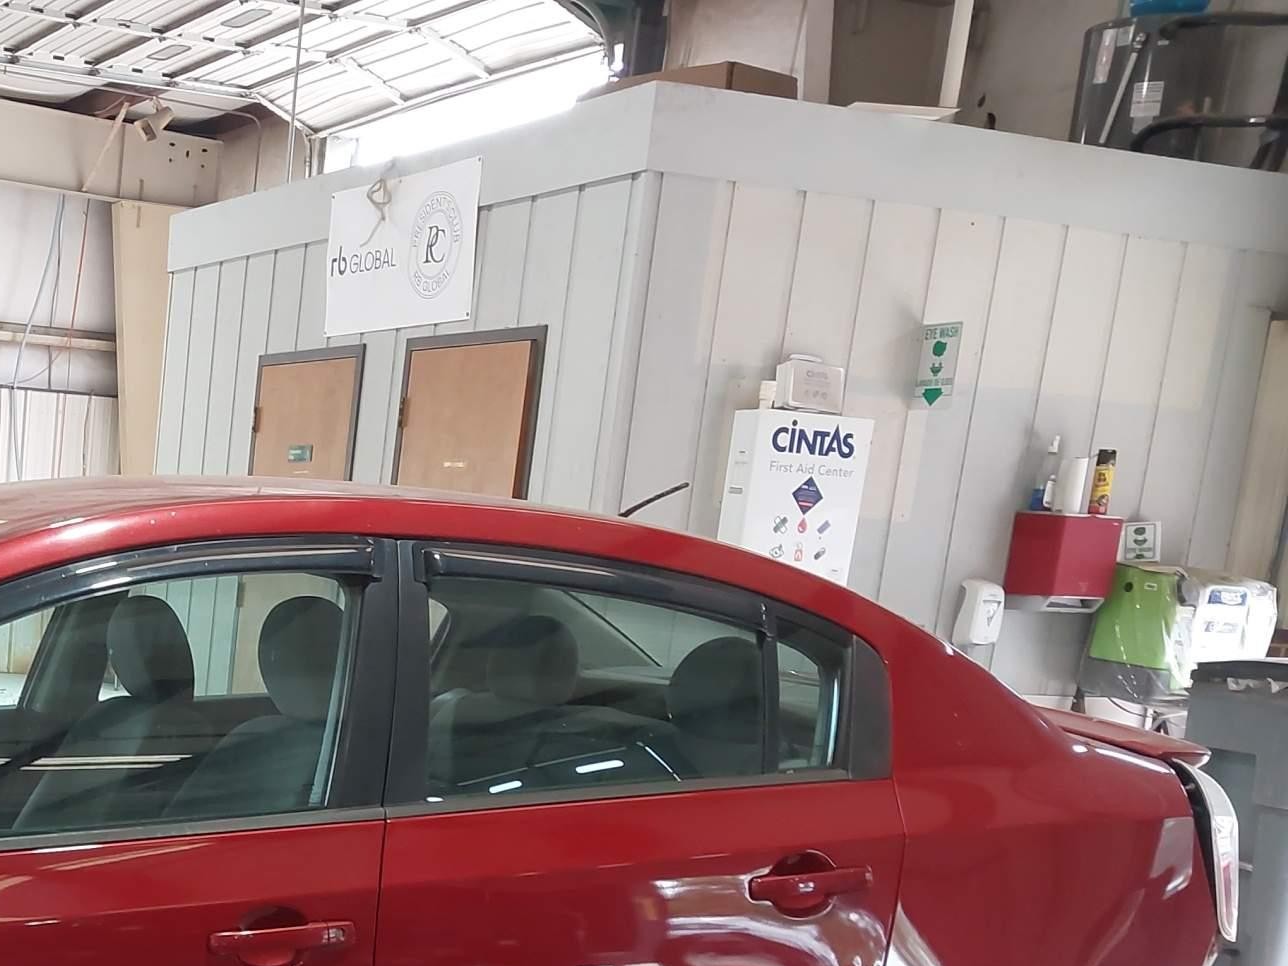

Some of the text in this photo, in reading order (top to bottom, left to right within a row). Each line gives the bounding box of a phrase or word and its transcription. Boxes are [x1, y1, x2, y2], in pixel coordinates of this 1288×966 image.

[330, 245, 397, 277] rb GLOBAL
[769, 461, 855, 478] First Aid Center
